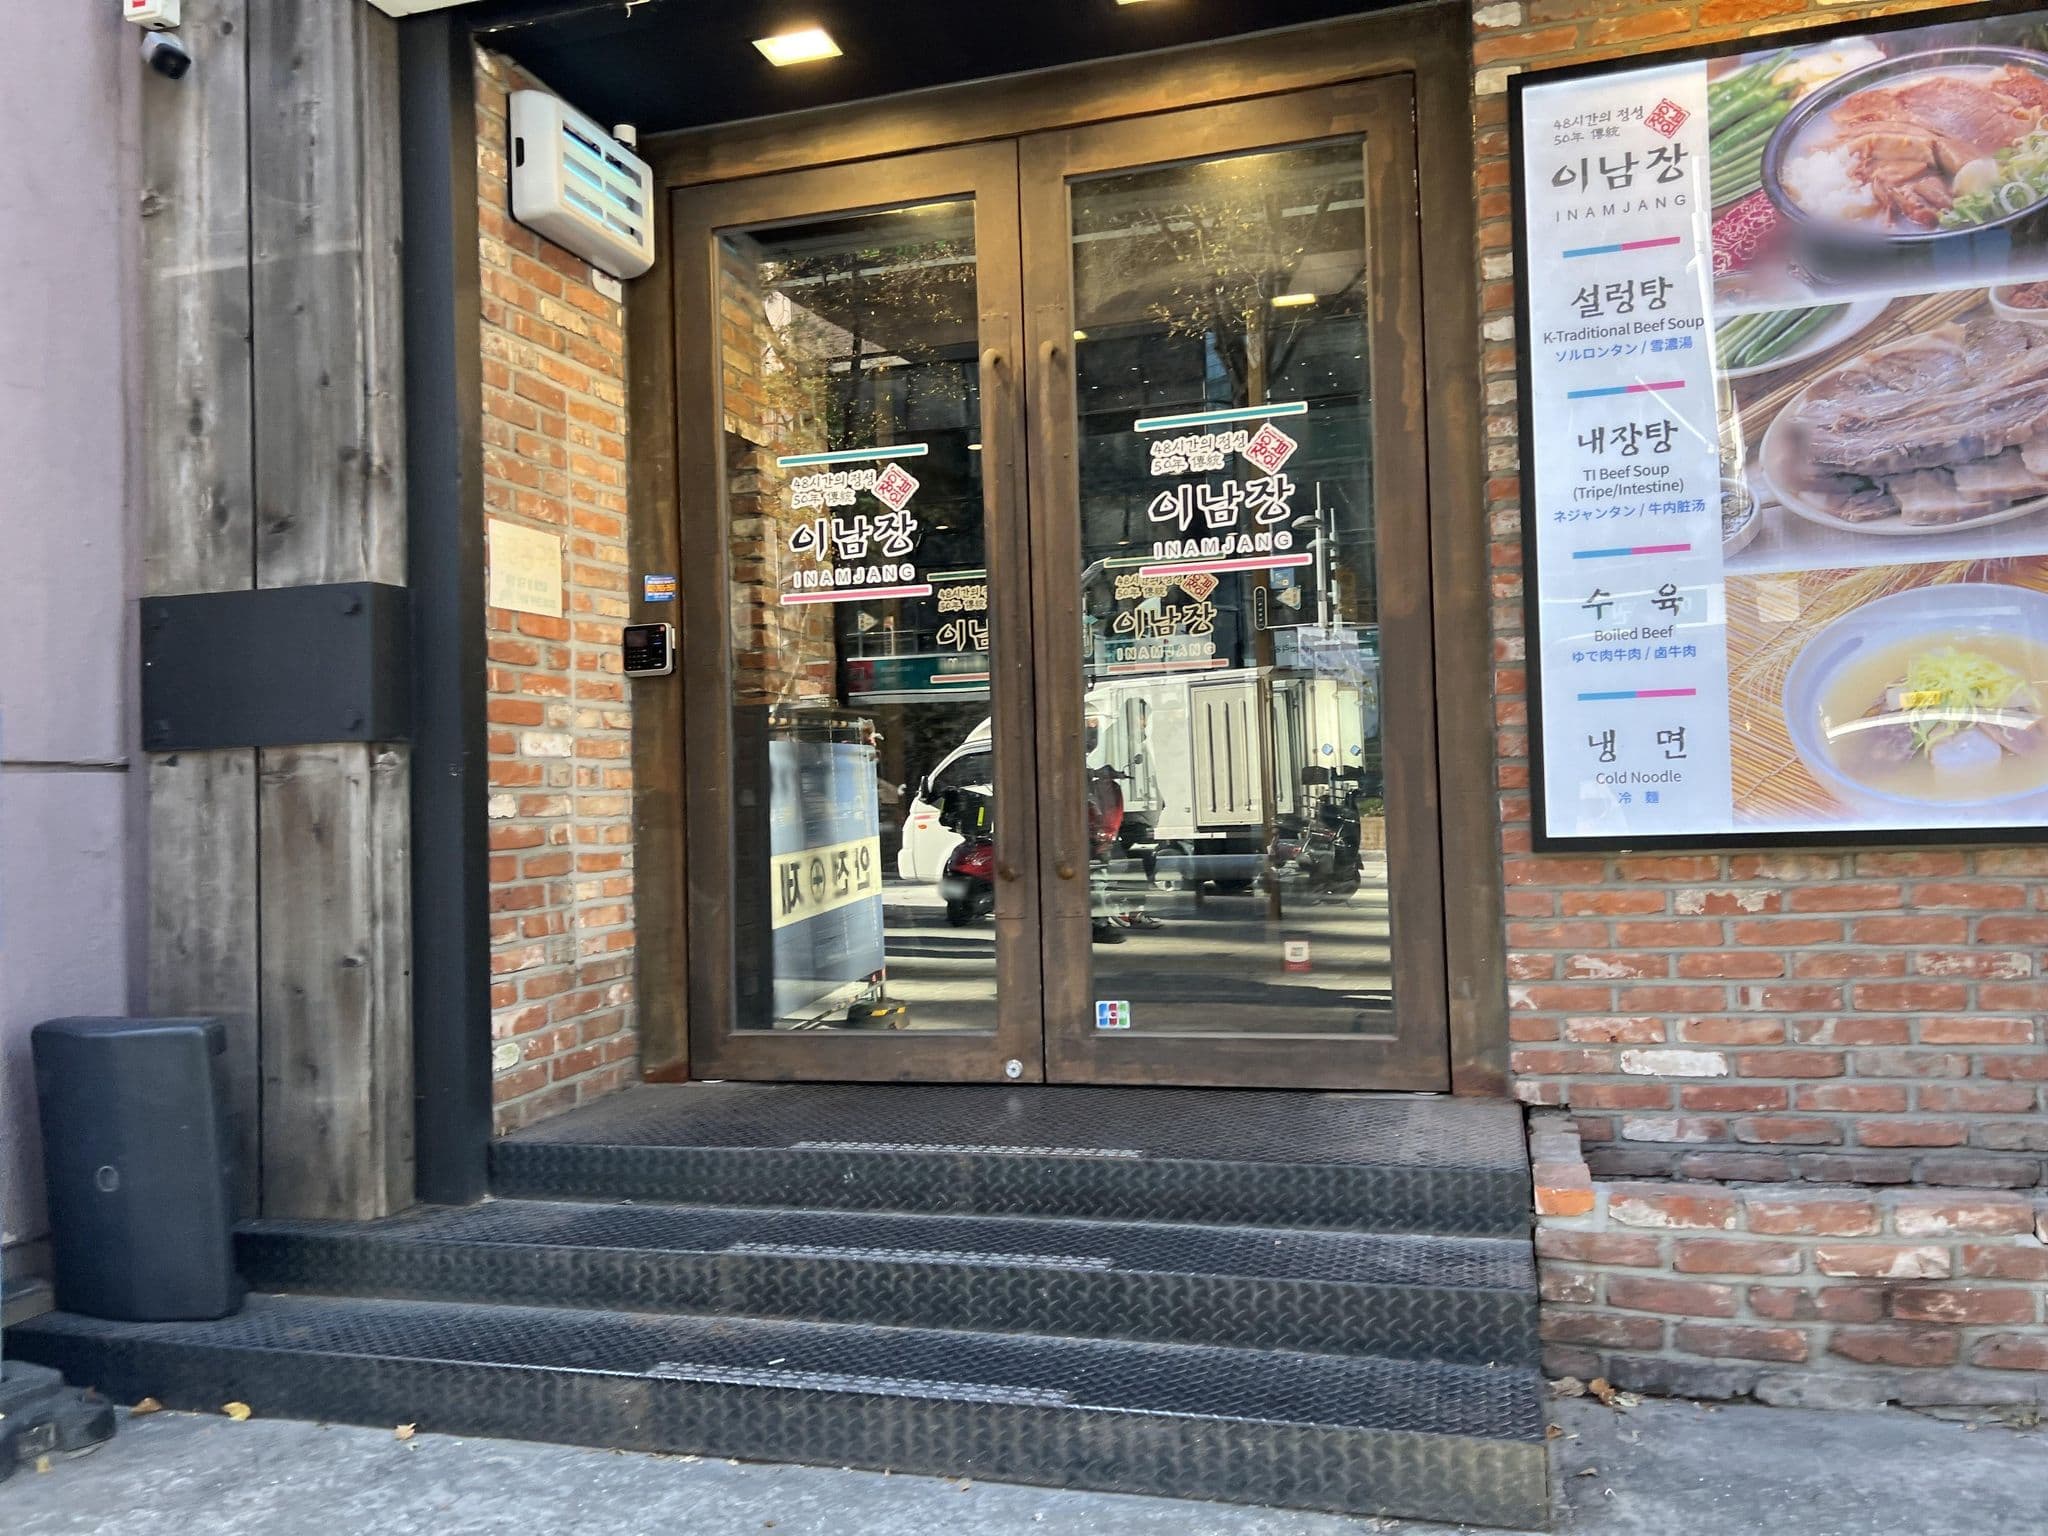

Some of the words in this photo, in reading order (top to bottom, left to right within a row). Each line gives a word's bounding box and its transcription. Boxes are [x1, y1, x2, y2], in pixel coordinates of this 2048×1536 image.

[1553, 110, 1611, 130] 48시간의
[1617, 105, 1645, 122] 정성
[1553, 132, 1584, 147] 50年
[1551, 143, 1689, 194] 이남장
[1556, 194, 1687, 223] INAMJANG
[1570, 276, 1674, 319] 설렁탕
[1543, 323, 1630, 344] K-Traditional
[1633, 318, 1665, 334] Beef
[1667, 316, 1705, 331] Soup
[1151, 434, 1214, 457] 48시간의
[1216, 430, 1248, 451] 정성
[1577, 419, 1679, 457] 내장탕
[792, 472, 847, 492] 48시간의
[849, 469, 876, 490] 정성
[1600, 466, 1630, 481] Beef
[1633, 464, 1670, 479] Soup
[1149, 474, 1294, 530] 이남장
[1572, 478, 1685, 502] (Tripe/Intestine)
[790, 511, 916, 560] 이남장
[1154, 532, 1292, 559] INAMJANG
[793, 563, 915, 588] INAMJANG
[1113, 602, 1217, 639] 이남장
[1594, 627, 1638, 642] Boiled
[1642, 625, 1674, 640] Beef
[1116, 642, 1216, 661] INAMJANG
[1595, 771, 1627, 785] Cold
[1630, 769, 1682, 784] Noodle
